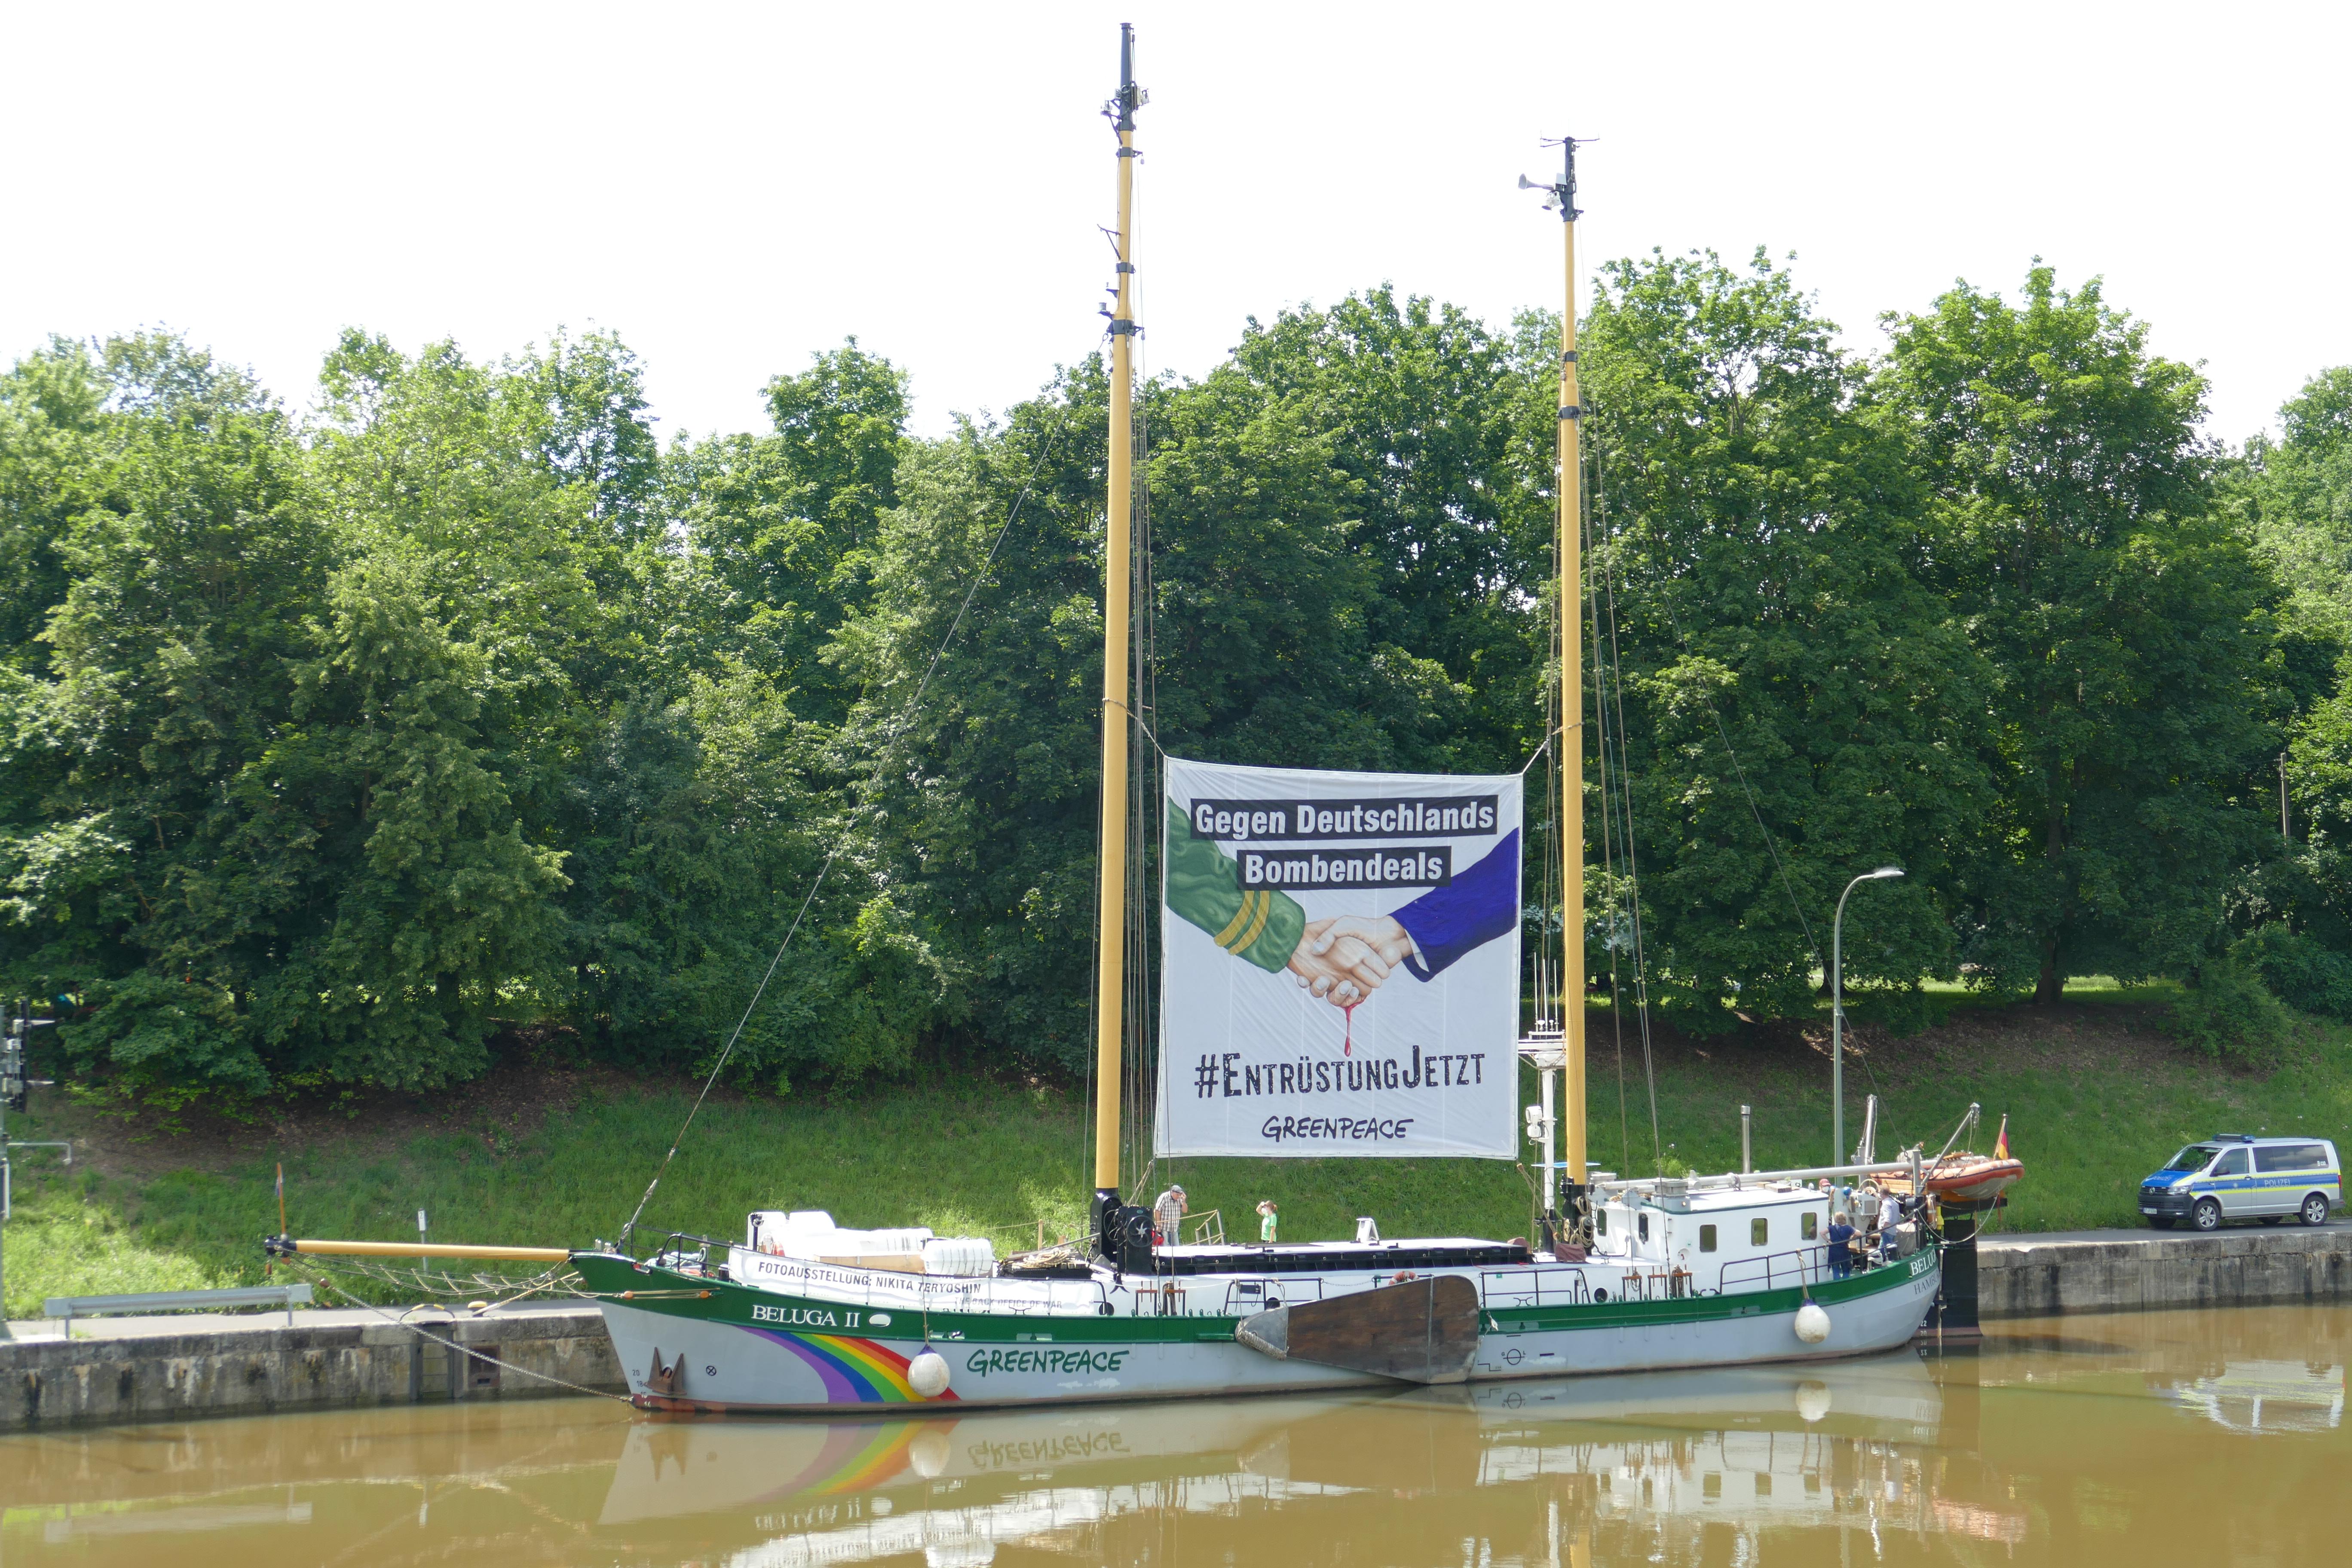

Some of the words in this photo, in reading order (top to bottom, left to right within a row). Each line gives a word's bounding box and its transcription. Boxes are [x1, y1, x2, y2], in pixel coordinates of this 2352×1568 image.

[1196, 804, 1286, 840] Gegen
[1297, 801, 1494, 833] Deutschlands
[1246, 852, 1442, 884] Bombendeals
[1262, 1115, 1414, 1142] GREENPEACE
[2264, 1179, 2291, 1187] POLIZEI
[876, 1277, 913, 1291] NIKITA
[918, 1282, 981, 1294] TERYOSHIN
[998, 1299, 1026, 1307] OFFICE
[1043, 1300, 1063, 1308] WAR
[751, 1305, 837, 1326] BELUGA
[844, 1312, 860, 1328] II
[966, 1349, 1130, 1377] GREENPEACE
